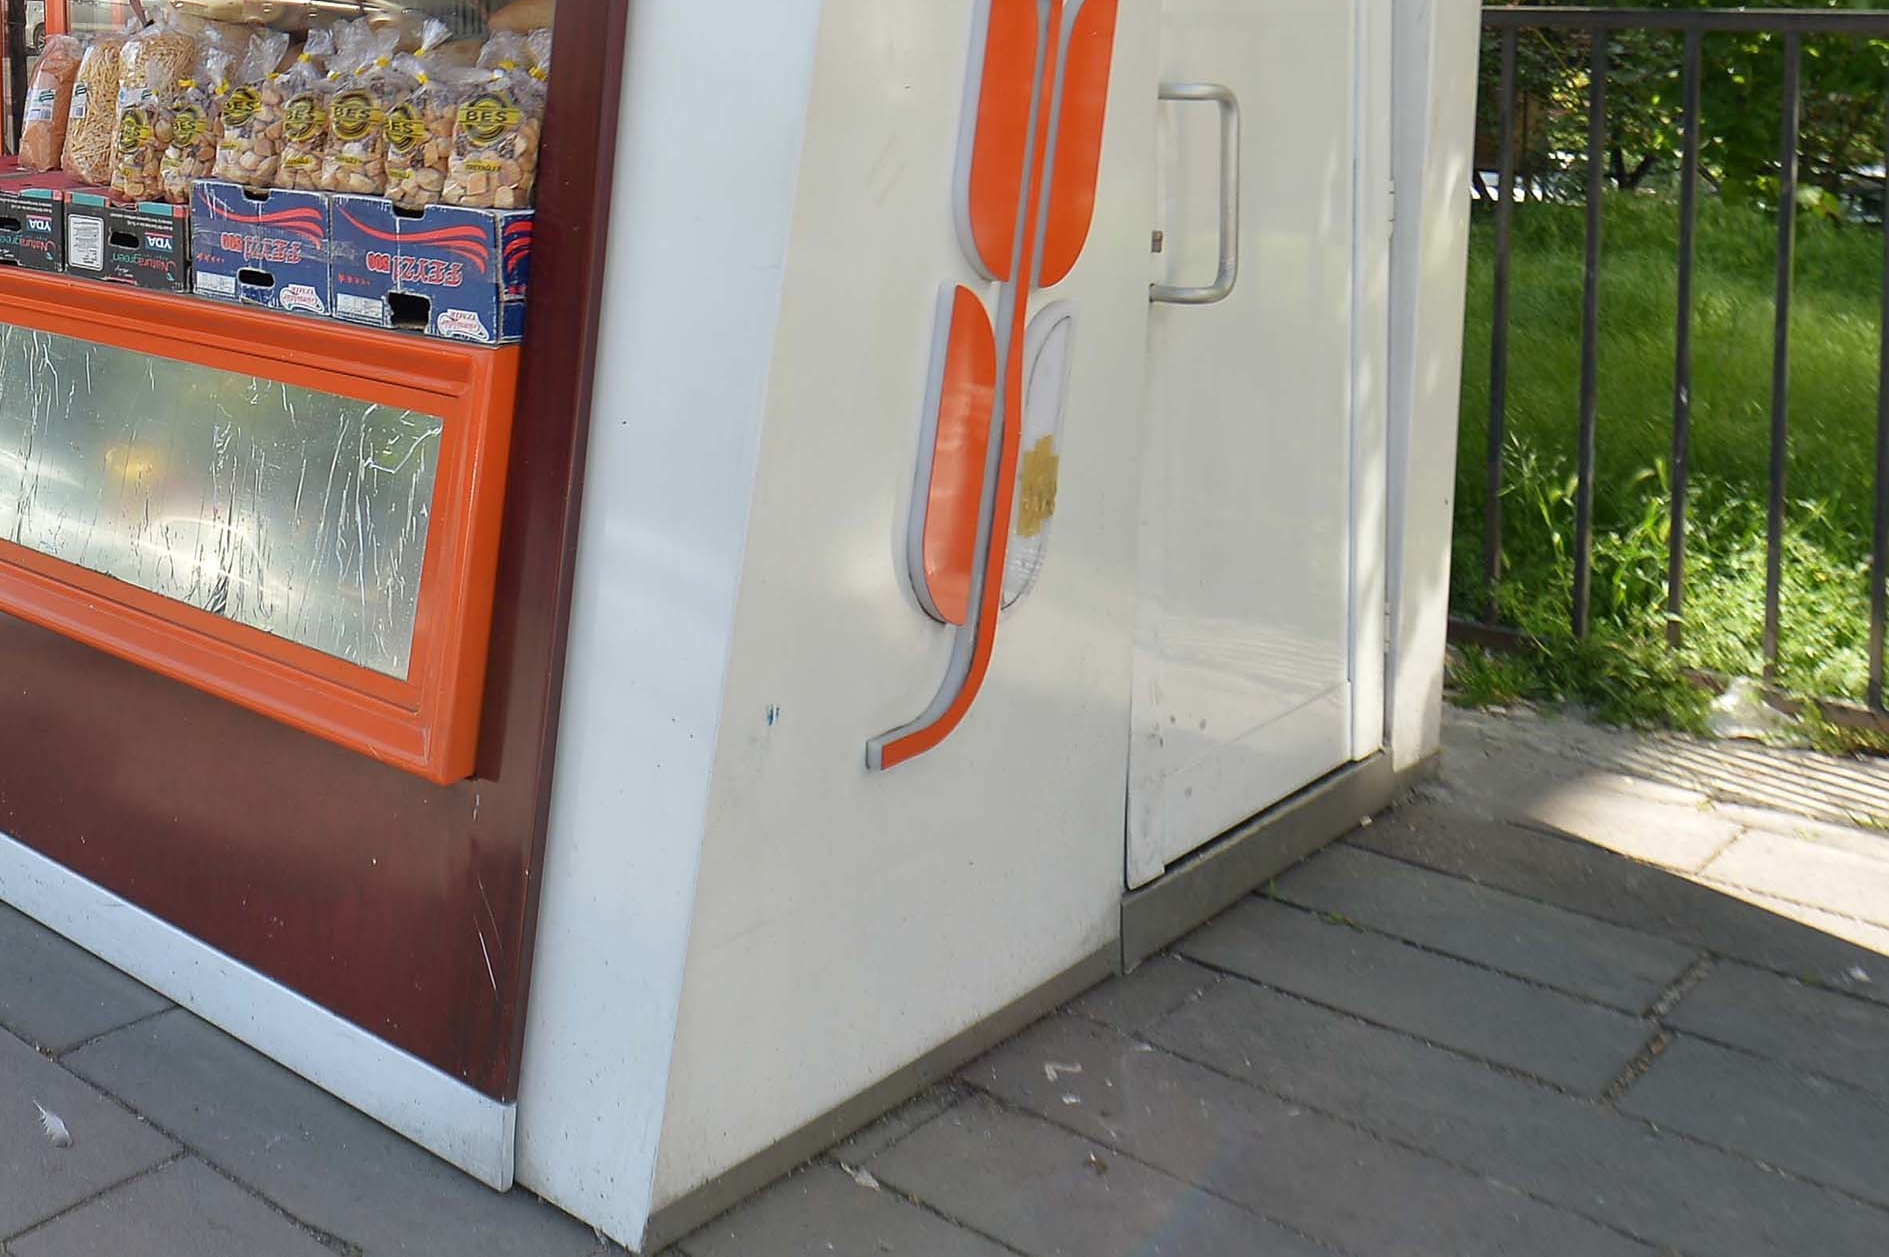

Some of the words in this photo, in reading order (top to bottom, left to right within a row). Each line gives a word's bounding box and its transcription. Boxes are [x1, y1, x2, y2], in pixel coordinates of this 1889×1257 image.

[466, 110, 506, 122] BES
[29, 219, 52, 232] YDA
[147, 235, 172, 250] YDA
